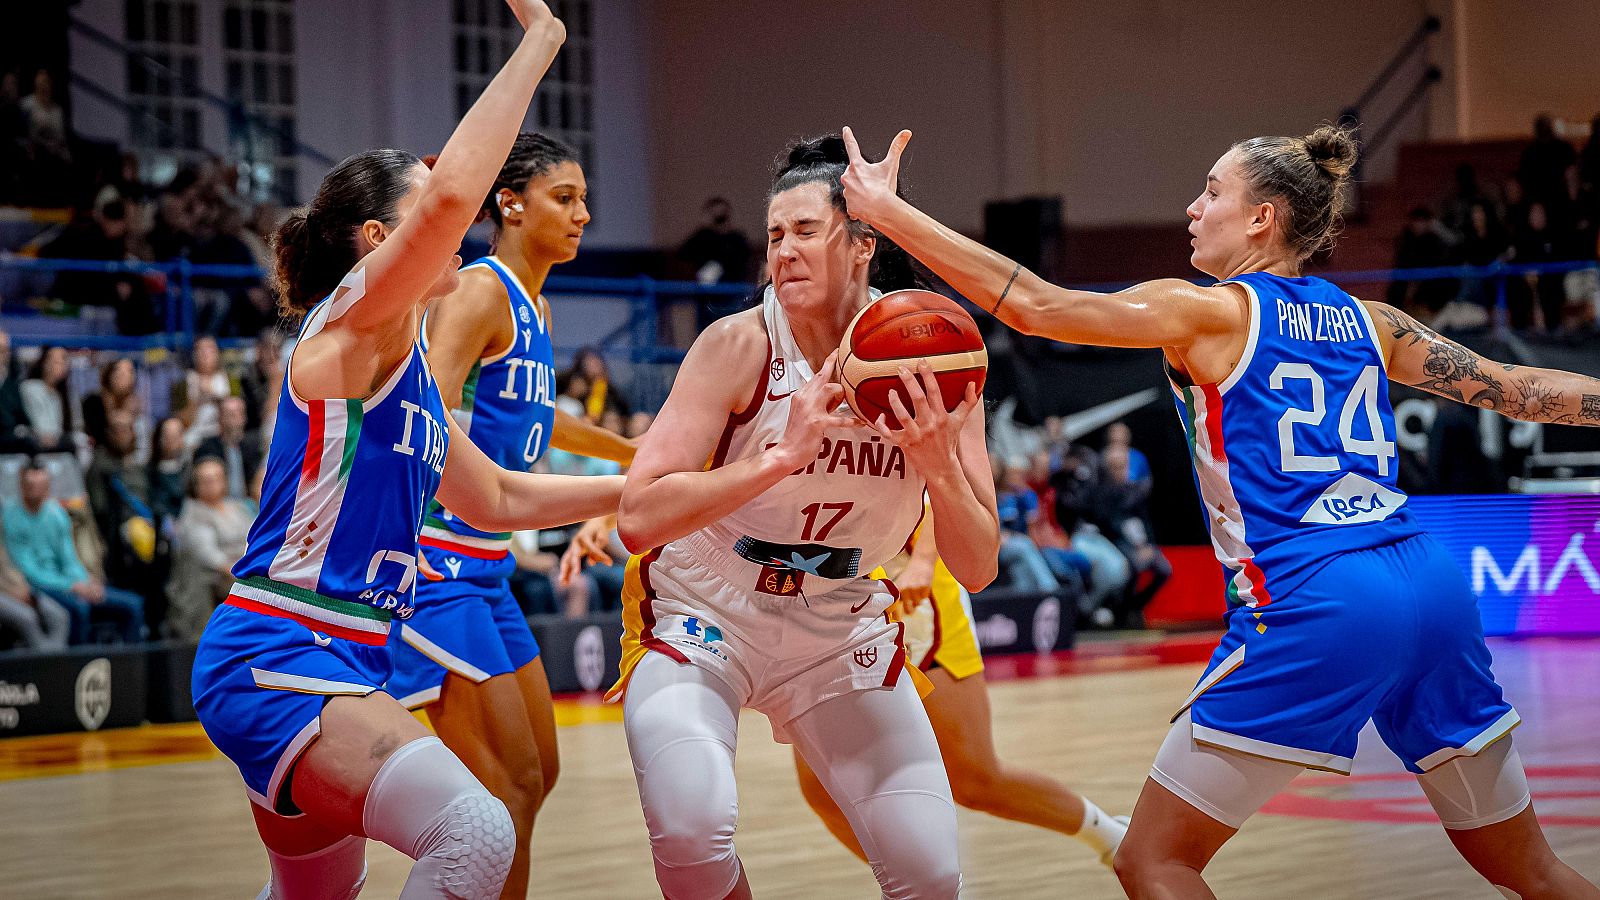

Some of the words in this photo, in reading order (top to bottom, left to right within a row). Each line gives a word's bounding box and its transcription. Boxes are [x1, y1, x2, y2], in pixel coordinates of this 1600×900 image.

[1276, 298, 1364, 343] PANZERA
[498, 357, 556, 409] ITAL
[392, 399, 449, 477] ITAL
[523, 421, 543, 463] 0
[1269, 362, 1395, 477] 24
[764, 435, 906, 480] PAÑA
[800, 501, 855, 542] 17
